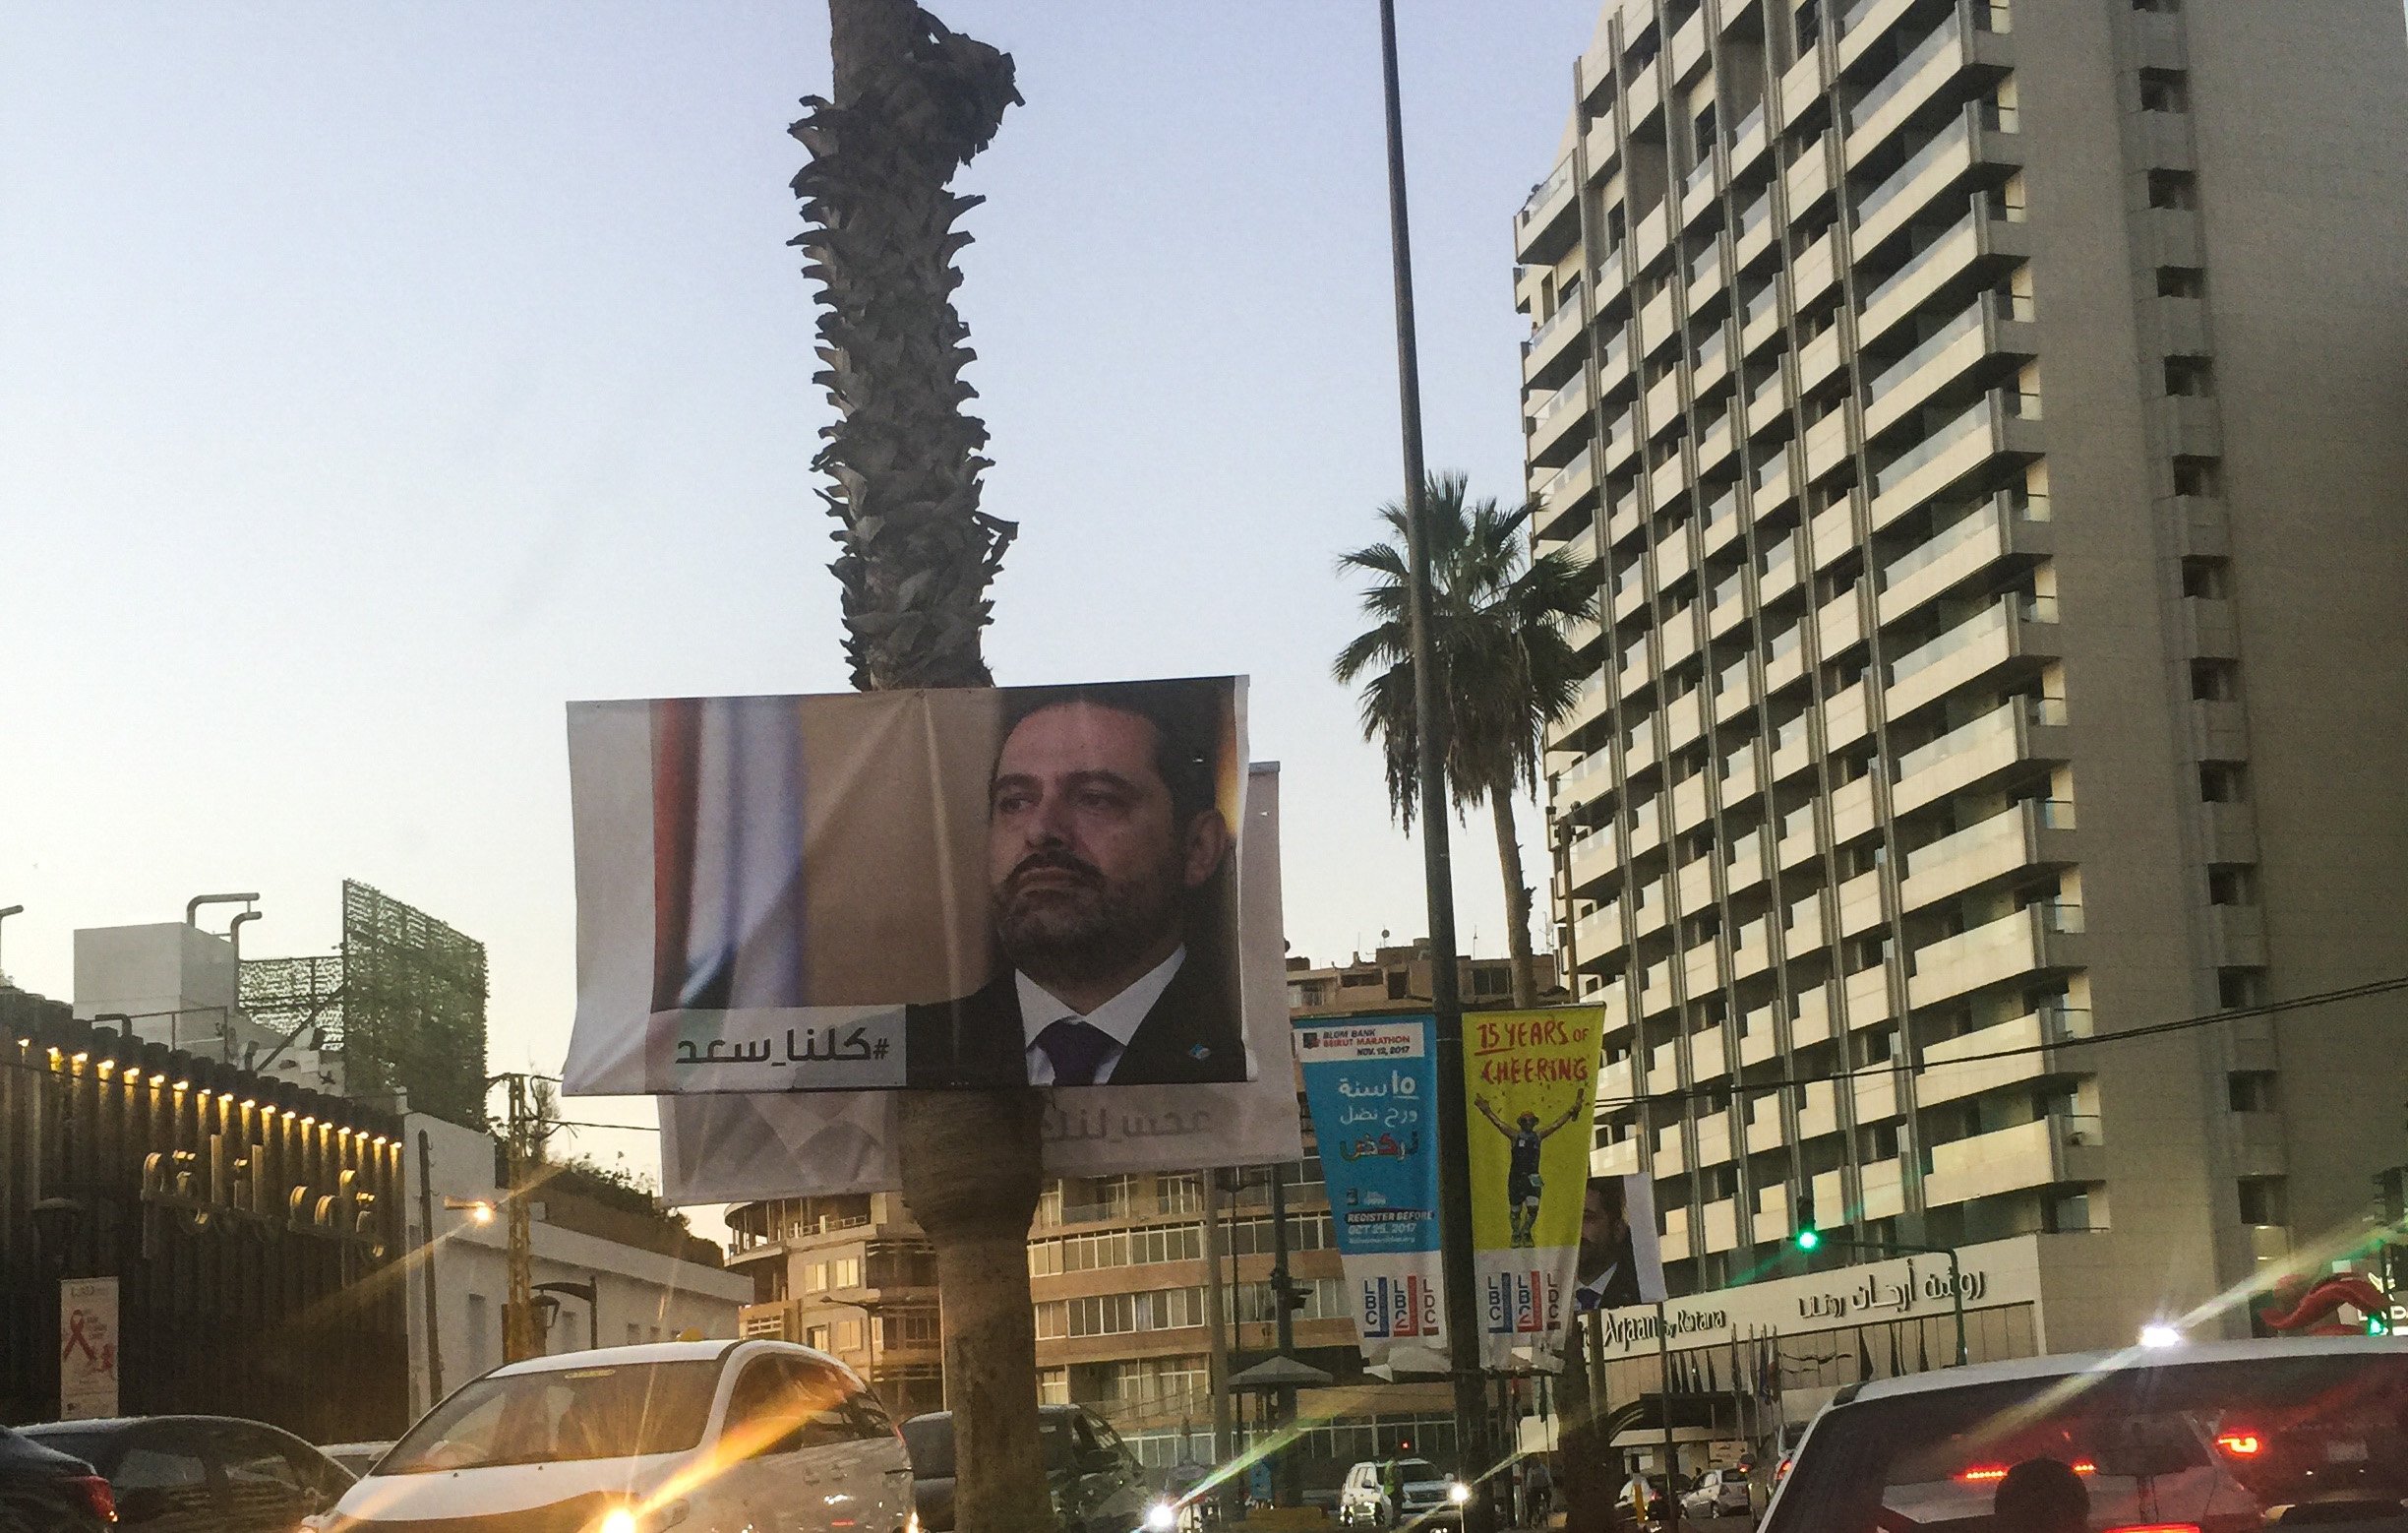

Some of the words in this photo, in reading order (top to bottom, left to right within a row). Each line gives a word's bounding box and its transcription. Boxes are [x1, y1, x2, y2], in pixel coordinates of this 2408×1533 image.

[1322, 1030, 1349, 1039] BLOM
[1351, 1028, 1376, 1038] BANK
[1322, 1038, 1354, 1048] BEIRUT
[1355, 1035, 1411, 1046] MARATHON
[1476, 1022, 1501, 1049] 15
[1505, 1020, 1569, 1047] YEARS
[1573, 1027, 1590, 1042] OF
[675, 1026, 890, 1068] #كلنا_سعد
[1390, 1046, 1411, 1055] 2017
[1481, 1056, 1589, 1085] CHEERING
[1339, 1077, 1388, 1097] سنة
[1347, 1212, 1395, 1223] REGISTER
[1396, 1210, 1433, 1221] BEFORE
[1348, 1224, 1370, 1235] OCT
[1391, 1222, 1417, 1234] 2017
[1850, 1258, 1918, 1314] أرجان
[1604, 1312, 1659, 1352] Arjaan
[1677, 1309, 1727, 1333] Rotana
